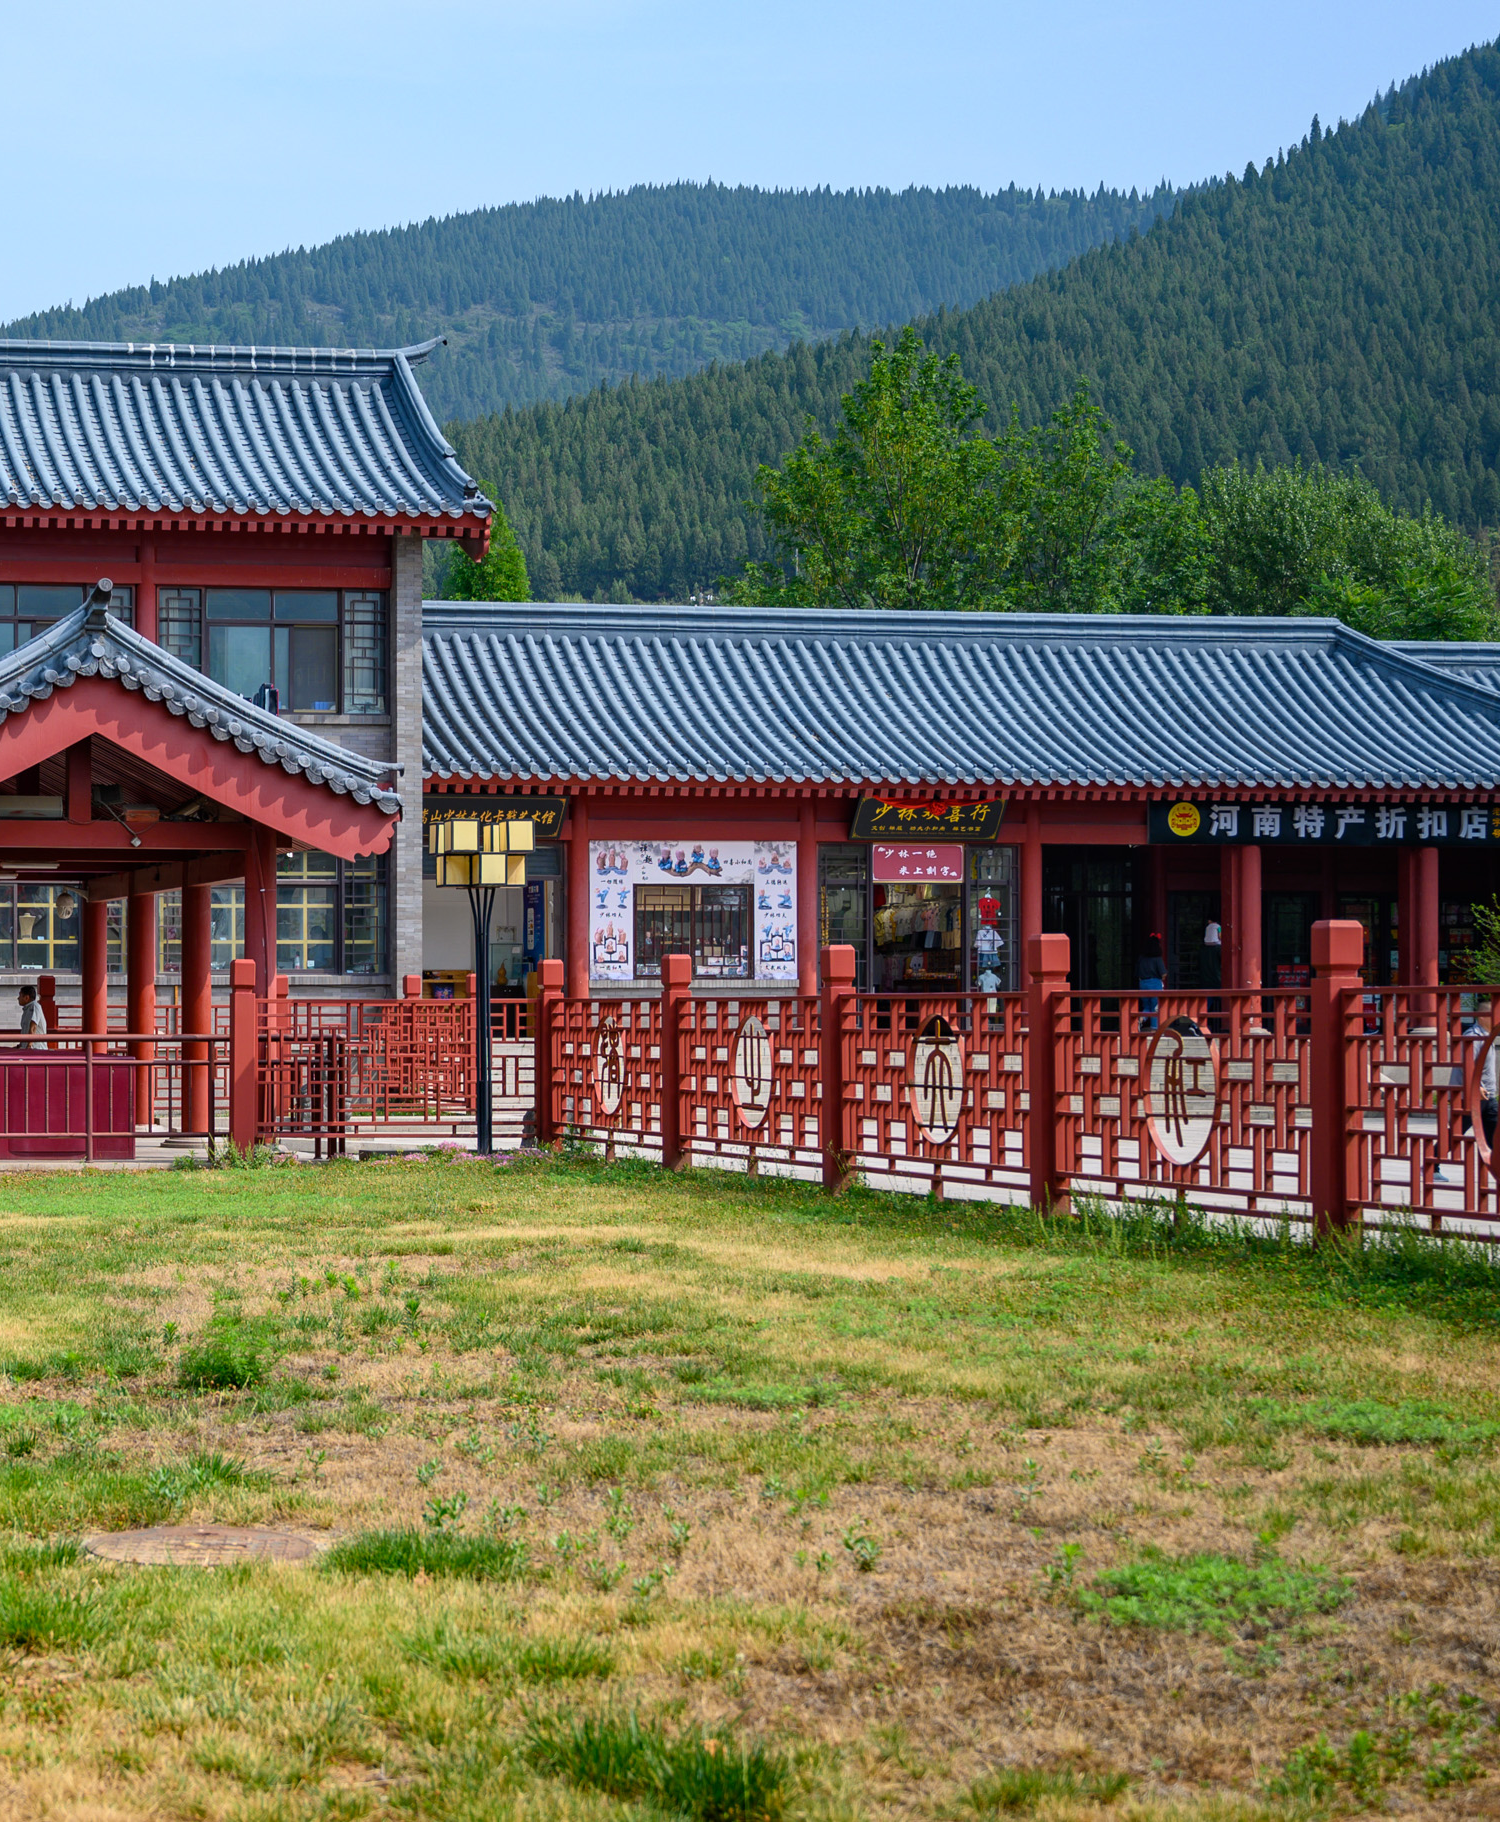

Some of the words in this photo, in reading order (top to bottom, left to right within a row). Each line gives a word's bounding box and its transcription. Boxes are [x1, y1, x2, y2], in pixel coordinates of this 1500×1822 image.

[1209, 804, 1488, 839] 河南特产折扣店
[884, 849, 938, 859] 少林一绝
[898, 866, 950, 876] 米上刻字
